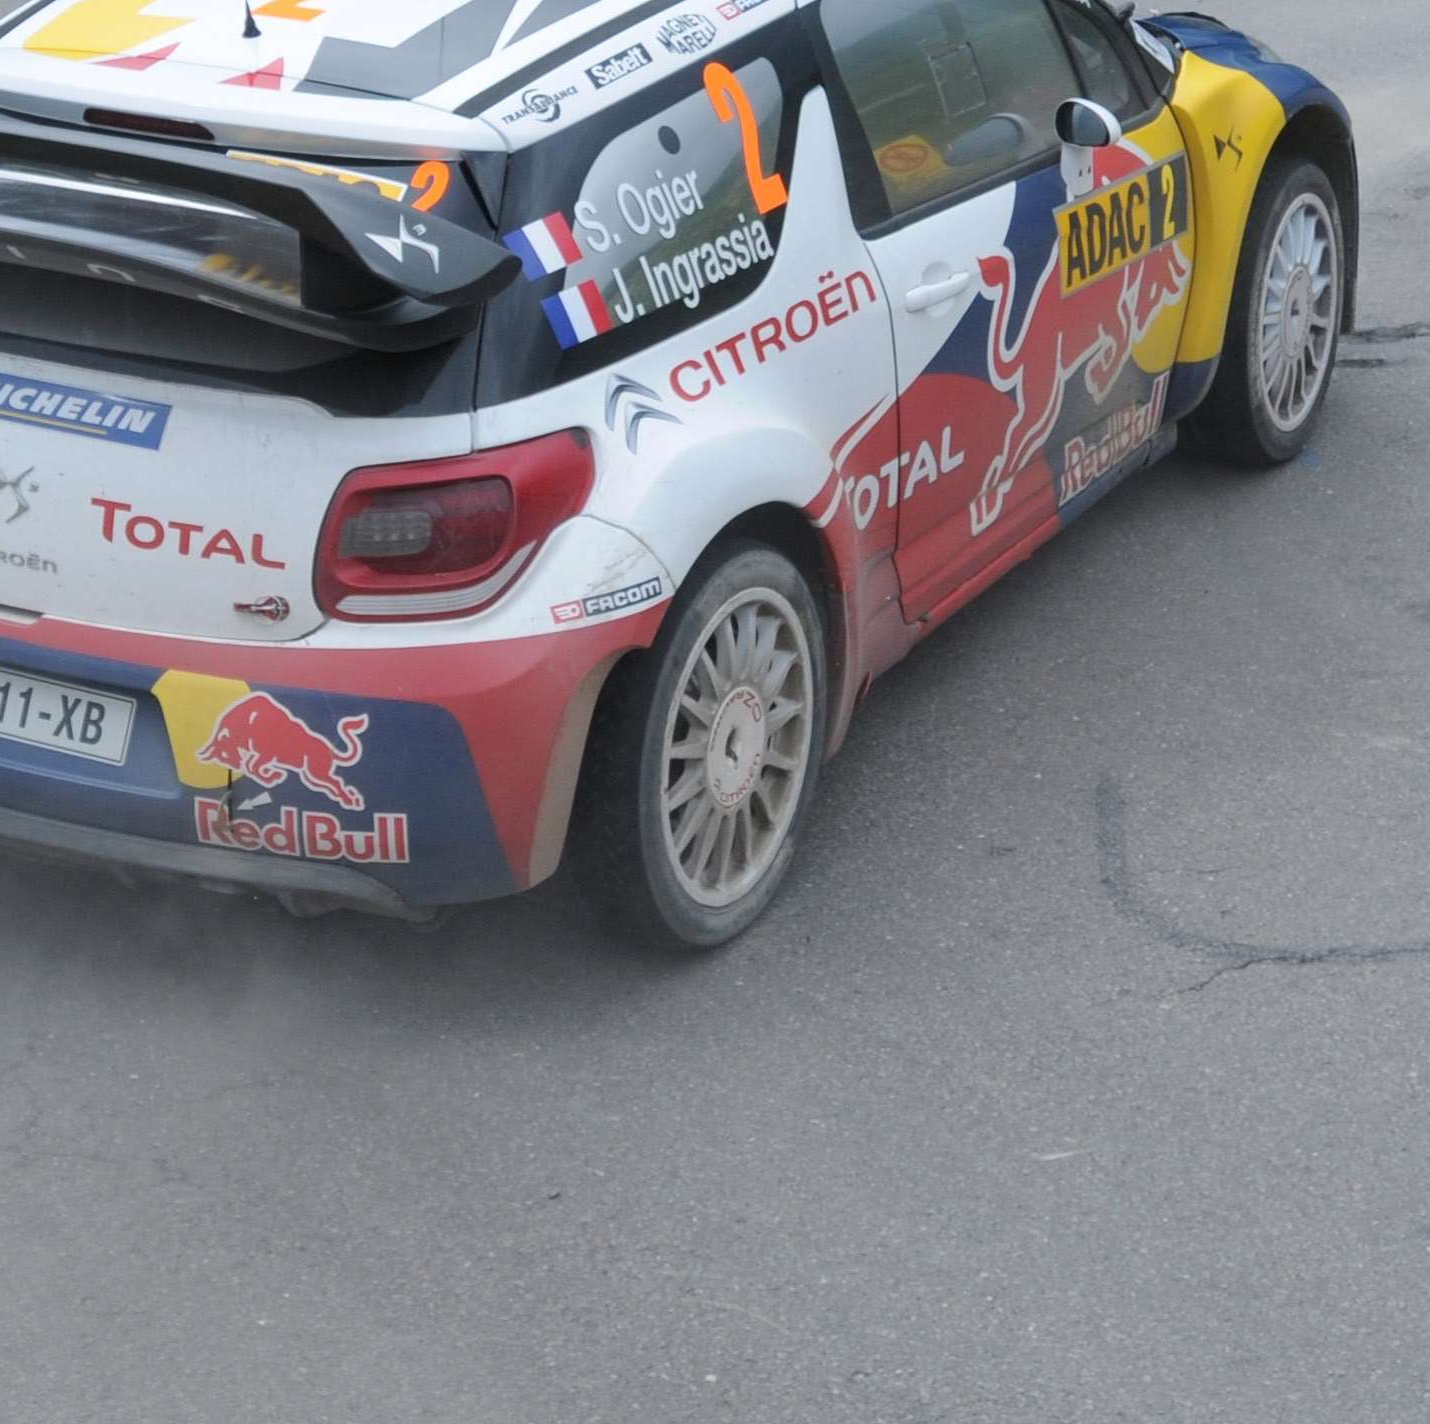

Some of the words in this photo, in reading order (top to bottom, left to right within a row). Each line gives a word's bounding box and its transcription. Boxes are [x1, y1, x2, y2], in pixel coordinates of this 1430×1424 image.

[589, 44, 649, 88] Sabelt
[703, 60, 787, 215] 2
[573, 200, 619, 253] S.
[616, 170, 704, 238] Ogier
[1066, 182, 1146, 288] ADAC
[1160, 164, 1176, 241] 2
[612, 282, 641, 325] J.
[641, 214, 776, 309] Ingrassia
[90, 497, 286, 571] TOTAL
